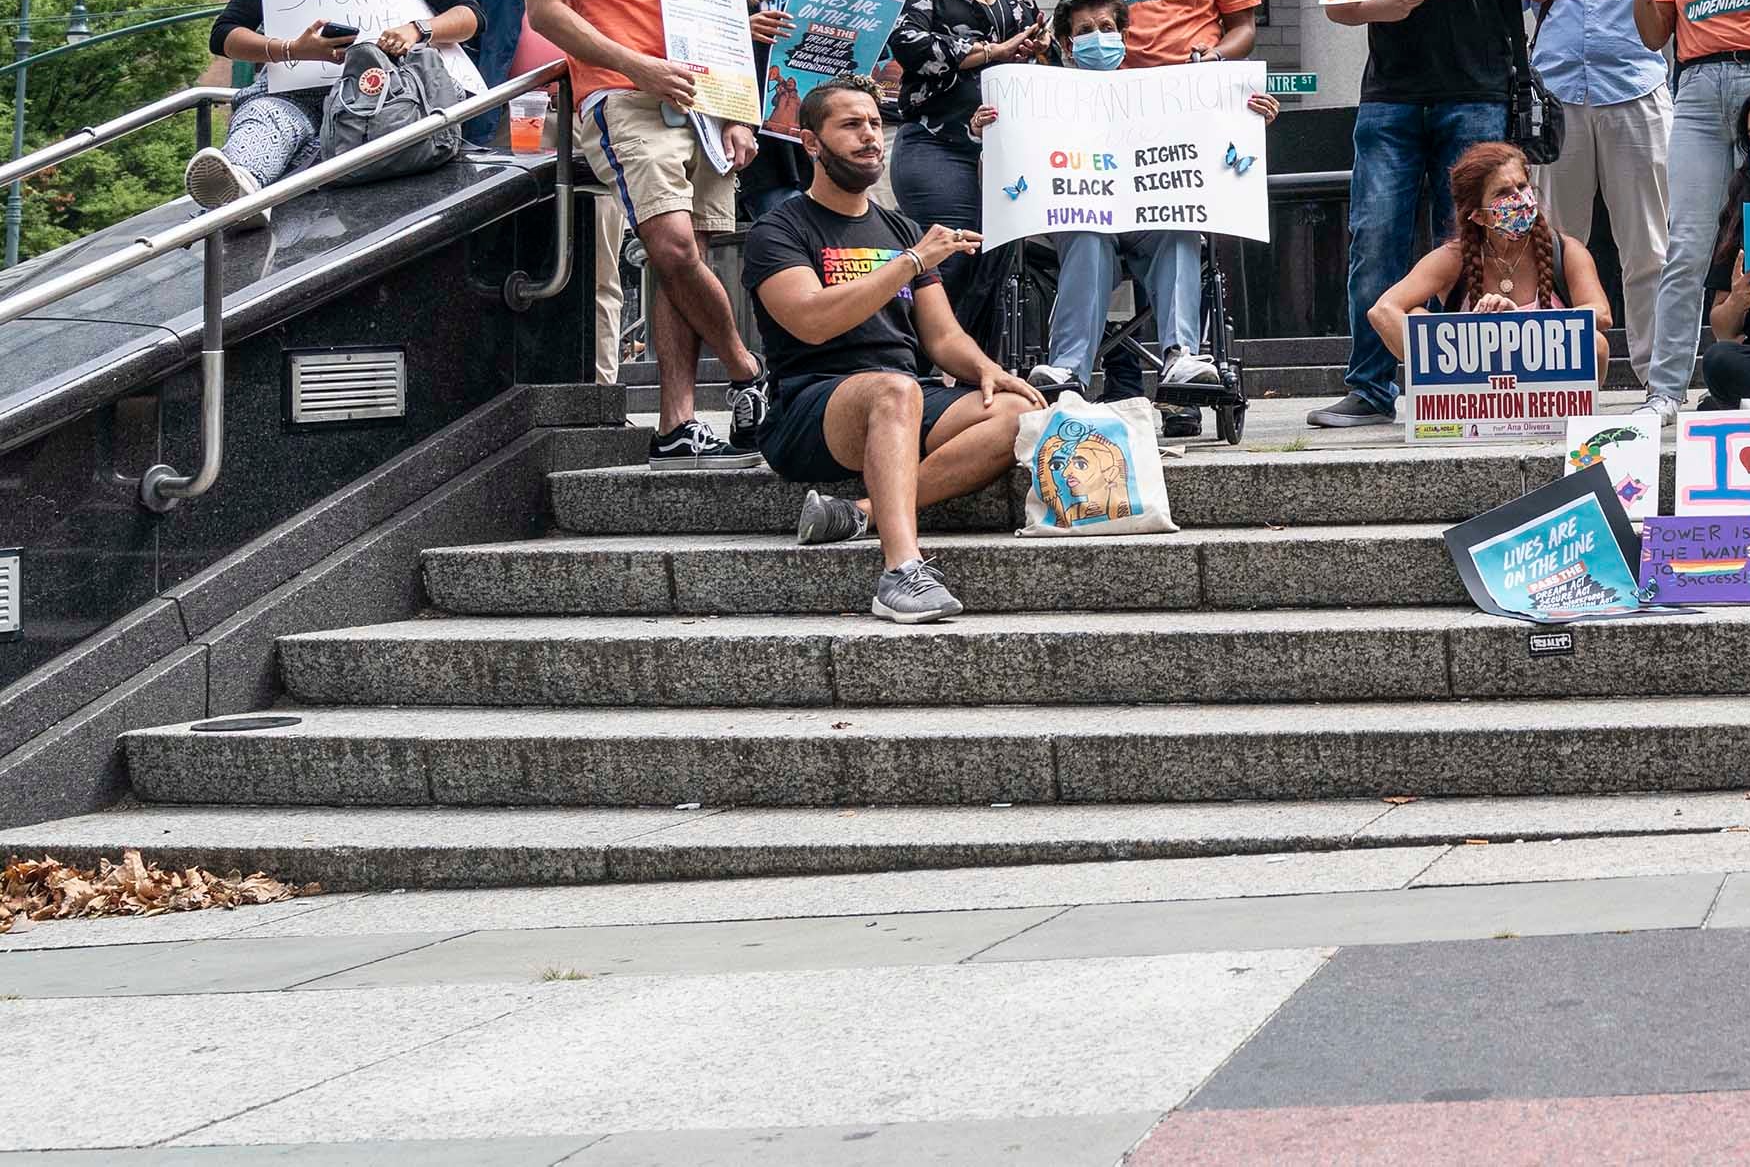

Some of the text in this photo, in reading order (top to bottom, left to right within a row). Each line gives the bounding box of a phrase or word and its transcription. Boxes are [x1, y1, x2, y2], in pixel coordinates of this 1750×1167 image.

[346, 9, 400, 33] wit
[798, 3, 883, 32] ON THE LINE
[811, 24, 857, 40] PASS THE
[803, 42, 849, 58] SECURE ACT
[805, 34, 851, 50] DREAM ACT
[788, 58, 837, 76] MODERNIZATION
[792, 50, 851, 68] FARM WORKFORCE
[1267, 75, 1313, 91] NTRE ST
[1134, 144, 1198, 168] RIGHTS
[1052, 170, 1204, 196] BLACK RIGHTS
[1047, 205, 1208, 226] HUMAN RIGHTS
[823, 260, 872, 273] STAND
[1417, 319, 1585, 375] I SUPPORT
[1490, 377, 1516, 390] THE
[1415, 390, 1592, 421] IMMIGRATION REFORM
[1507, 423, 1522, 431] Ana
[1524, 423, 1550, 432] Oliveira
[1650, 524, 1721, 542] POWER
[1503, 516, 1577, 570] LIVES ARE
[1504, 531, 1595, 589] ON THE LINE
[1652, 546, 1688, 560] THE
[1652, 562, 1673, 575] TO
[1531, 565, 1583, 592] PASS THE
[1535, 575, 1586, 600] DREAM ACT
[1540, 584, 1592, 603] SECURE ACT
